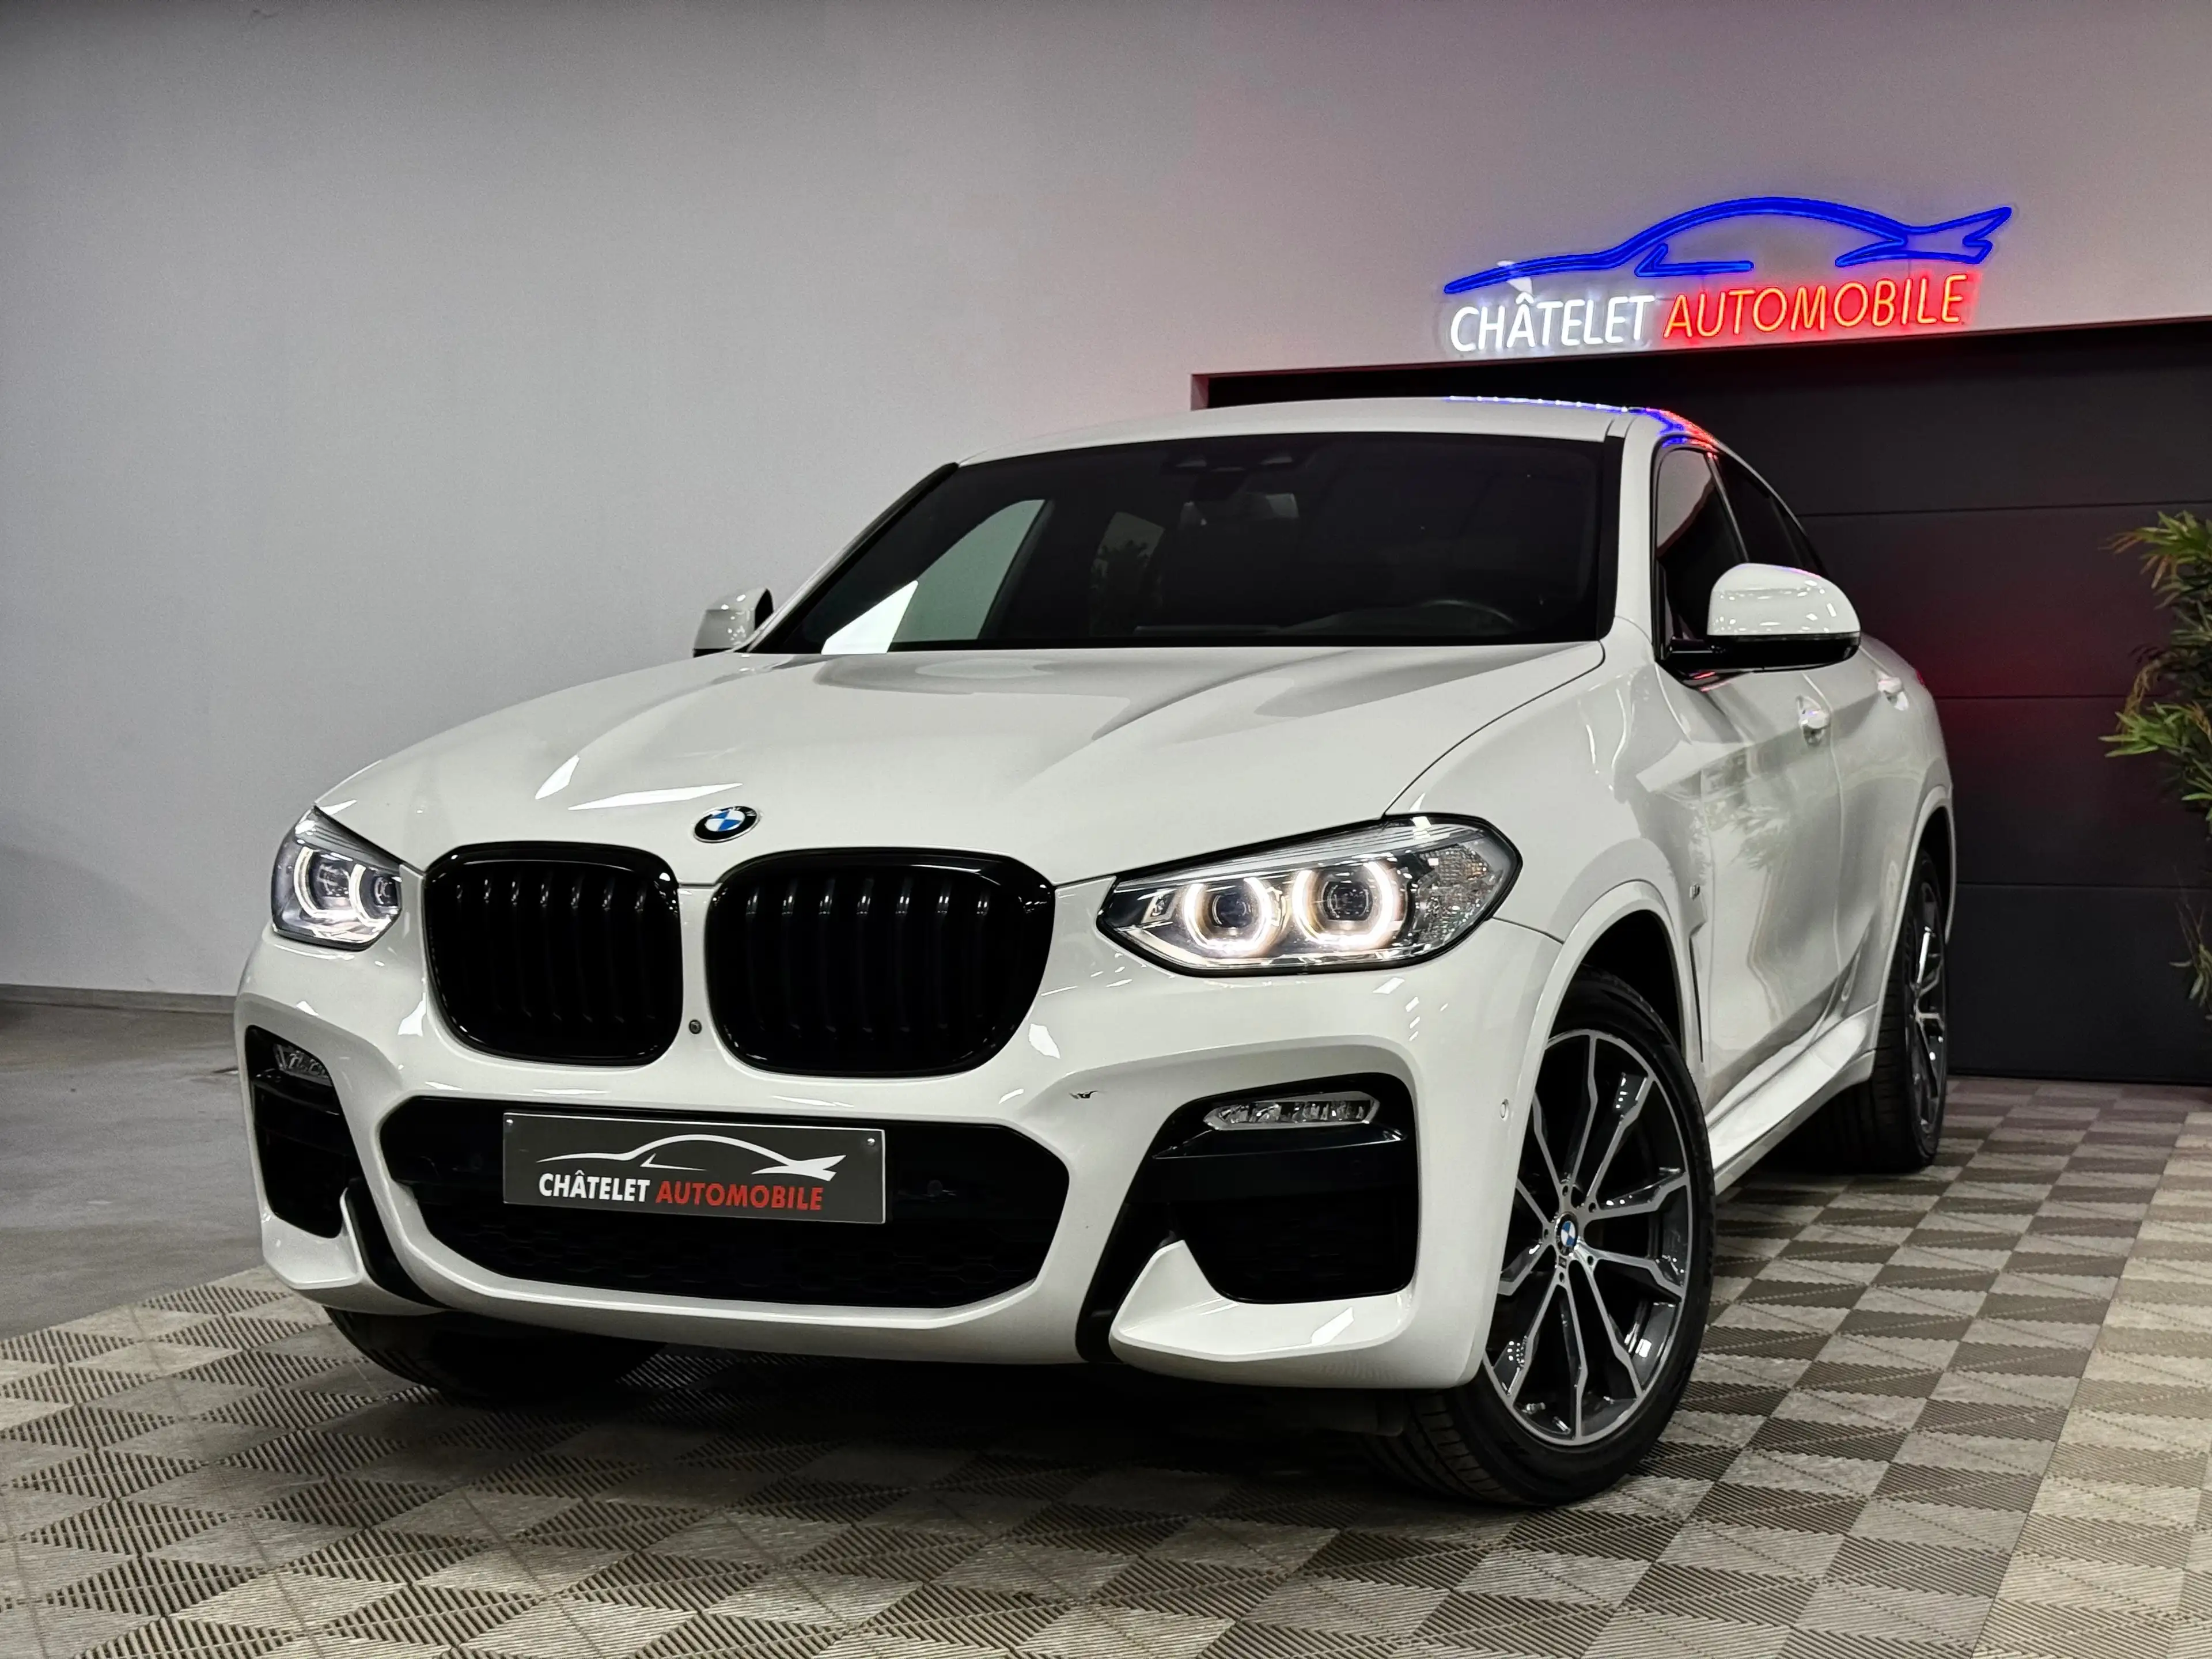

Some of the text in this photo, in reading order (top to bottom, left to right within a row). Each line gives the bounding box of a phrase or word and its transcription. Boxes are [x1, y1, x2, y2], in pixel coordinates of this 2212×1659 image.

[1450, 274, 1968, 352] CHÂTELET AUTOMOBILE
[539, 1169, 824, 1210] CHÂTELET AUTOMOBILE
